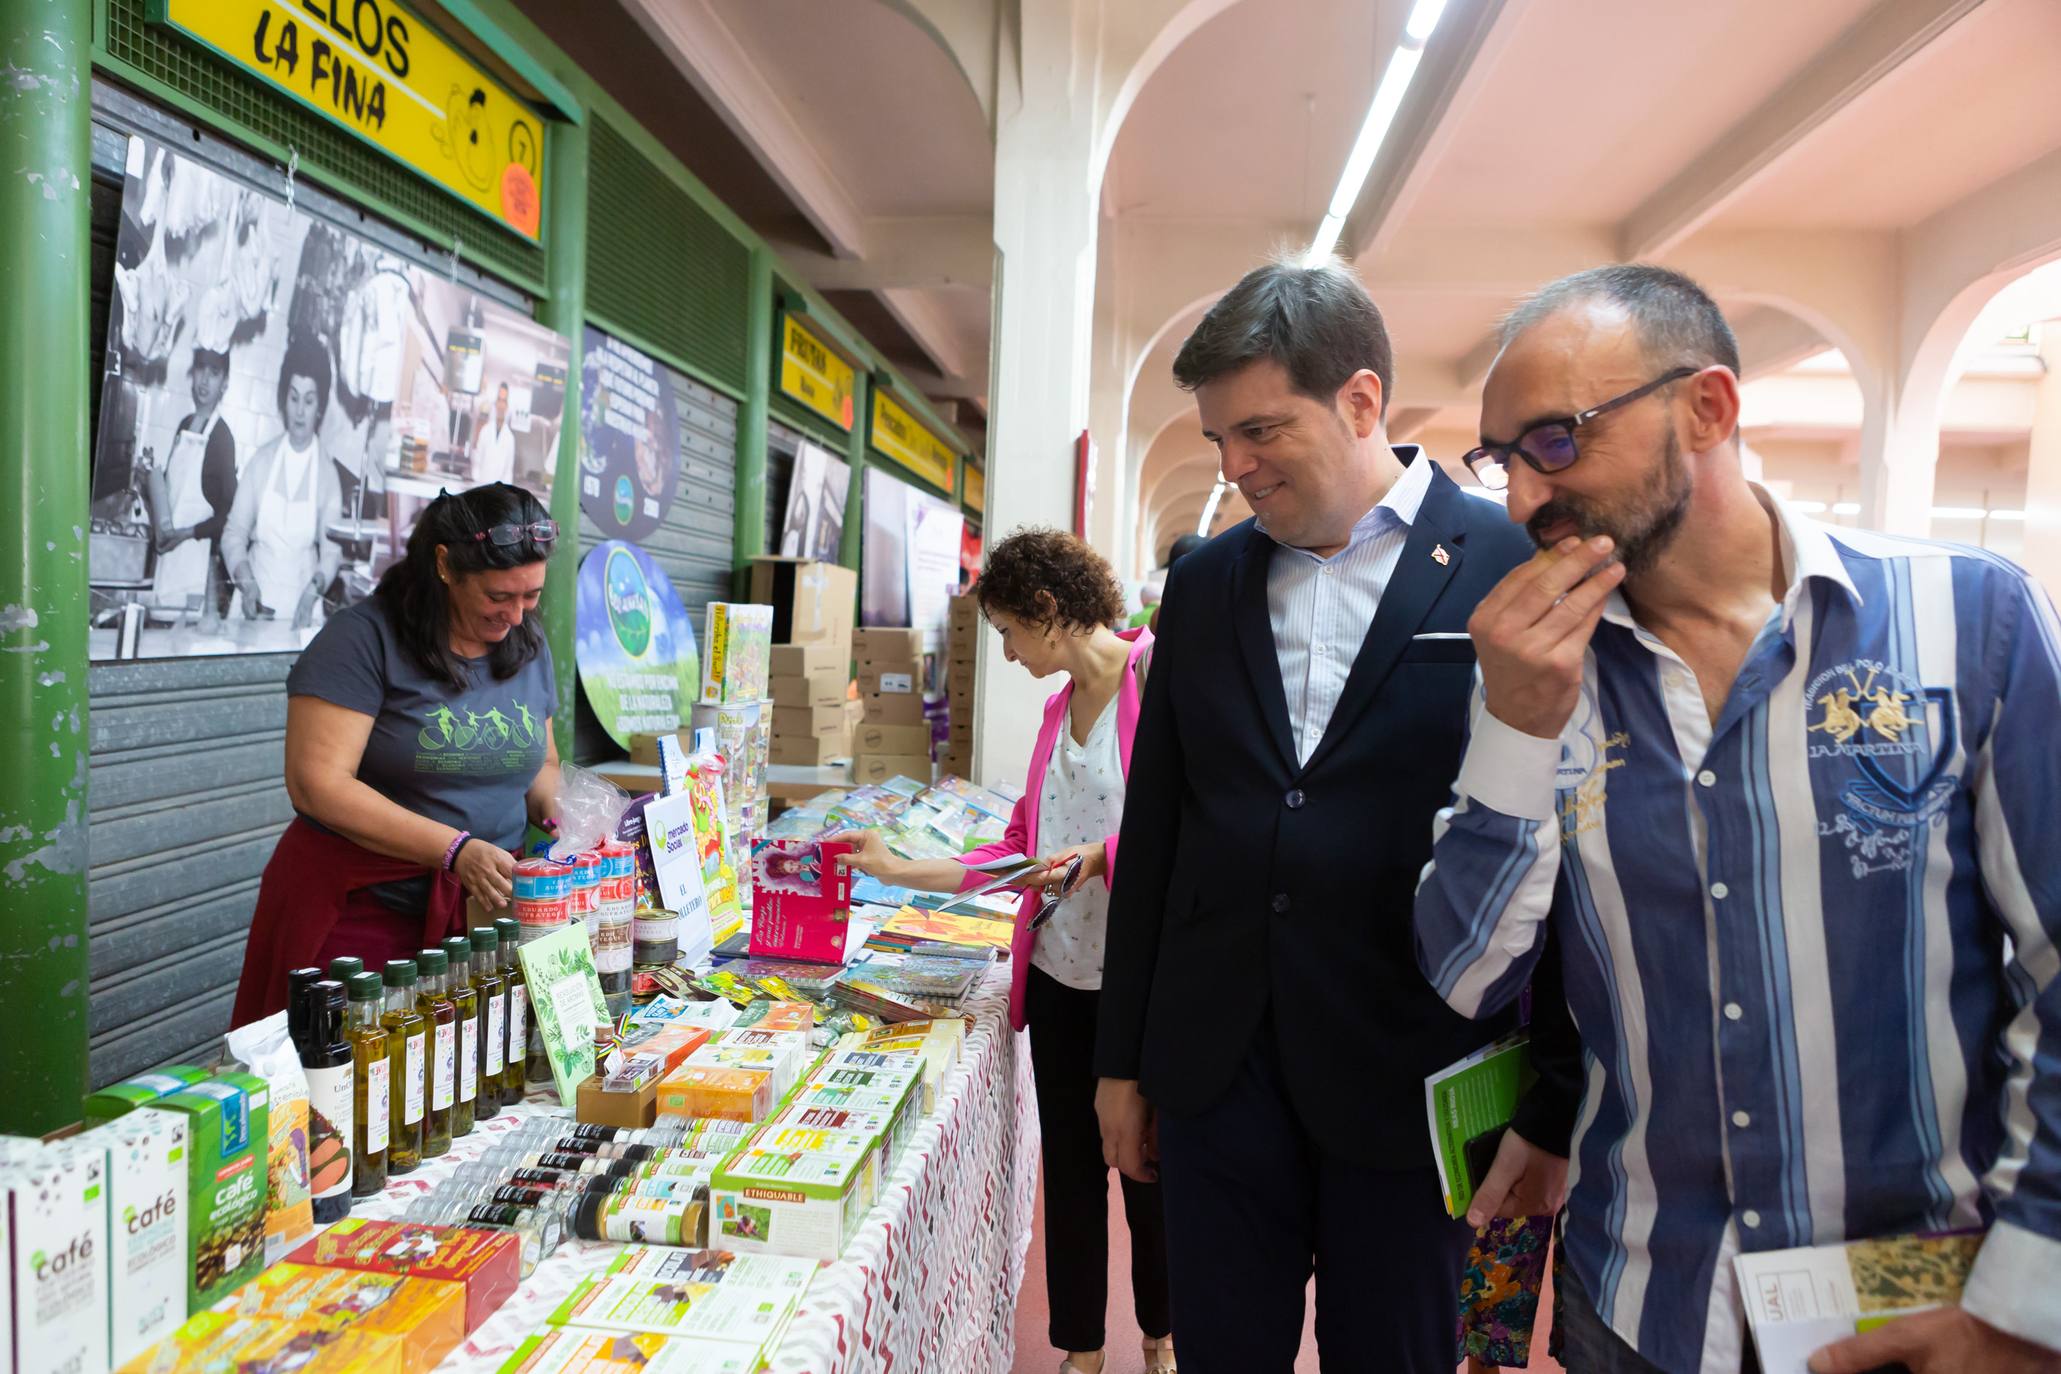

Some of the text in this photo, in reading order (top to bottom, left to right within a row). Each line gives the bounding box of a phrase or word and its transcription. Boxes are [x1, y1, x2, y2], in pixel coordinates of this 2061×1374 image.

[253, 9, 387, 132] LA FINA
[666, 837, 683, 854] Social
[667, 820, 689, 841] mercado
[208, 1189, 258, 1222] ecológico
[213, 1171, 254, 1206] café
[744, 1188, 804, 1203] ETHIQUABLE
[128, 1188, 176, 1235] café
[36, 1230, 93, 1282] café
